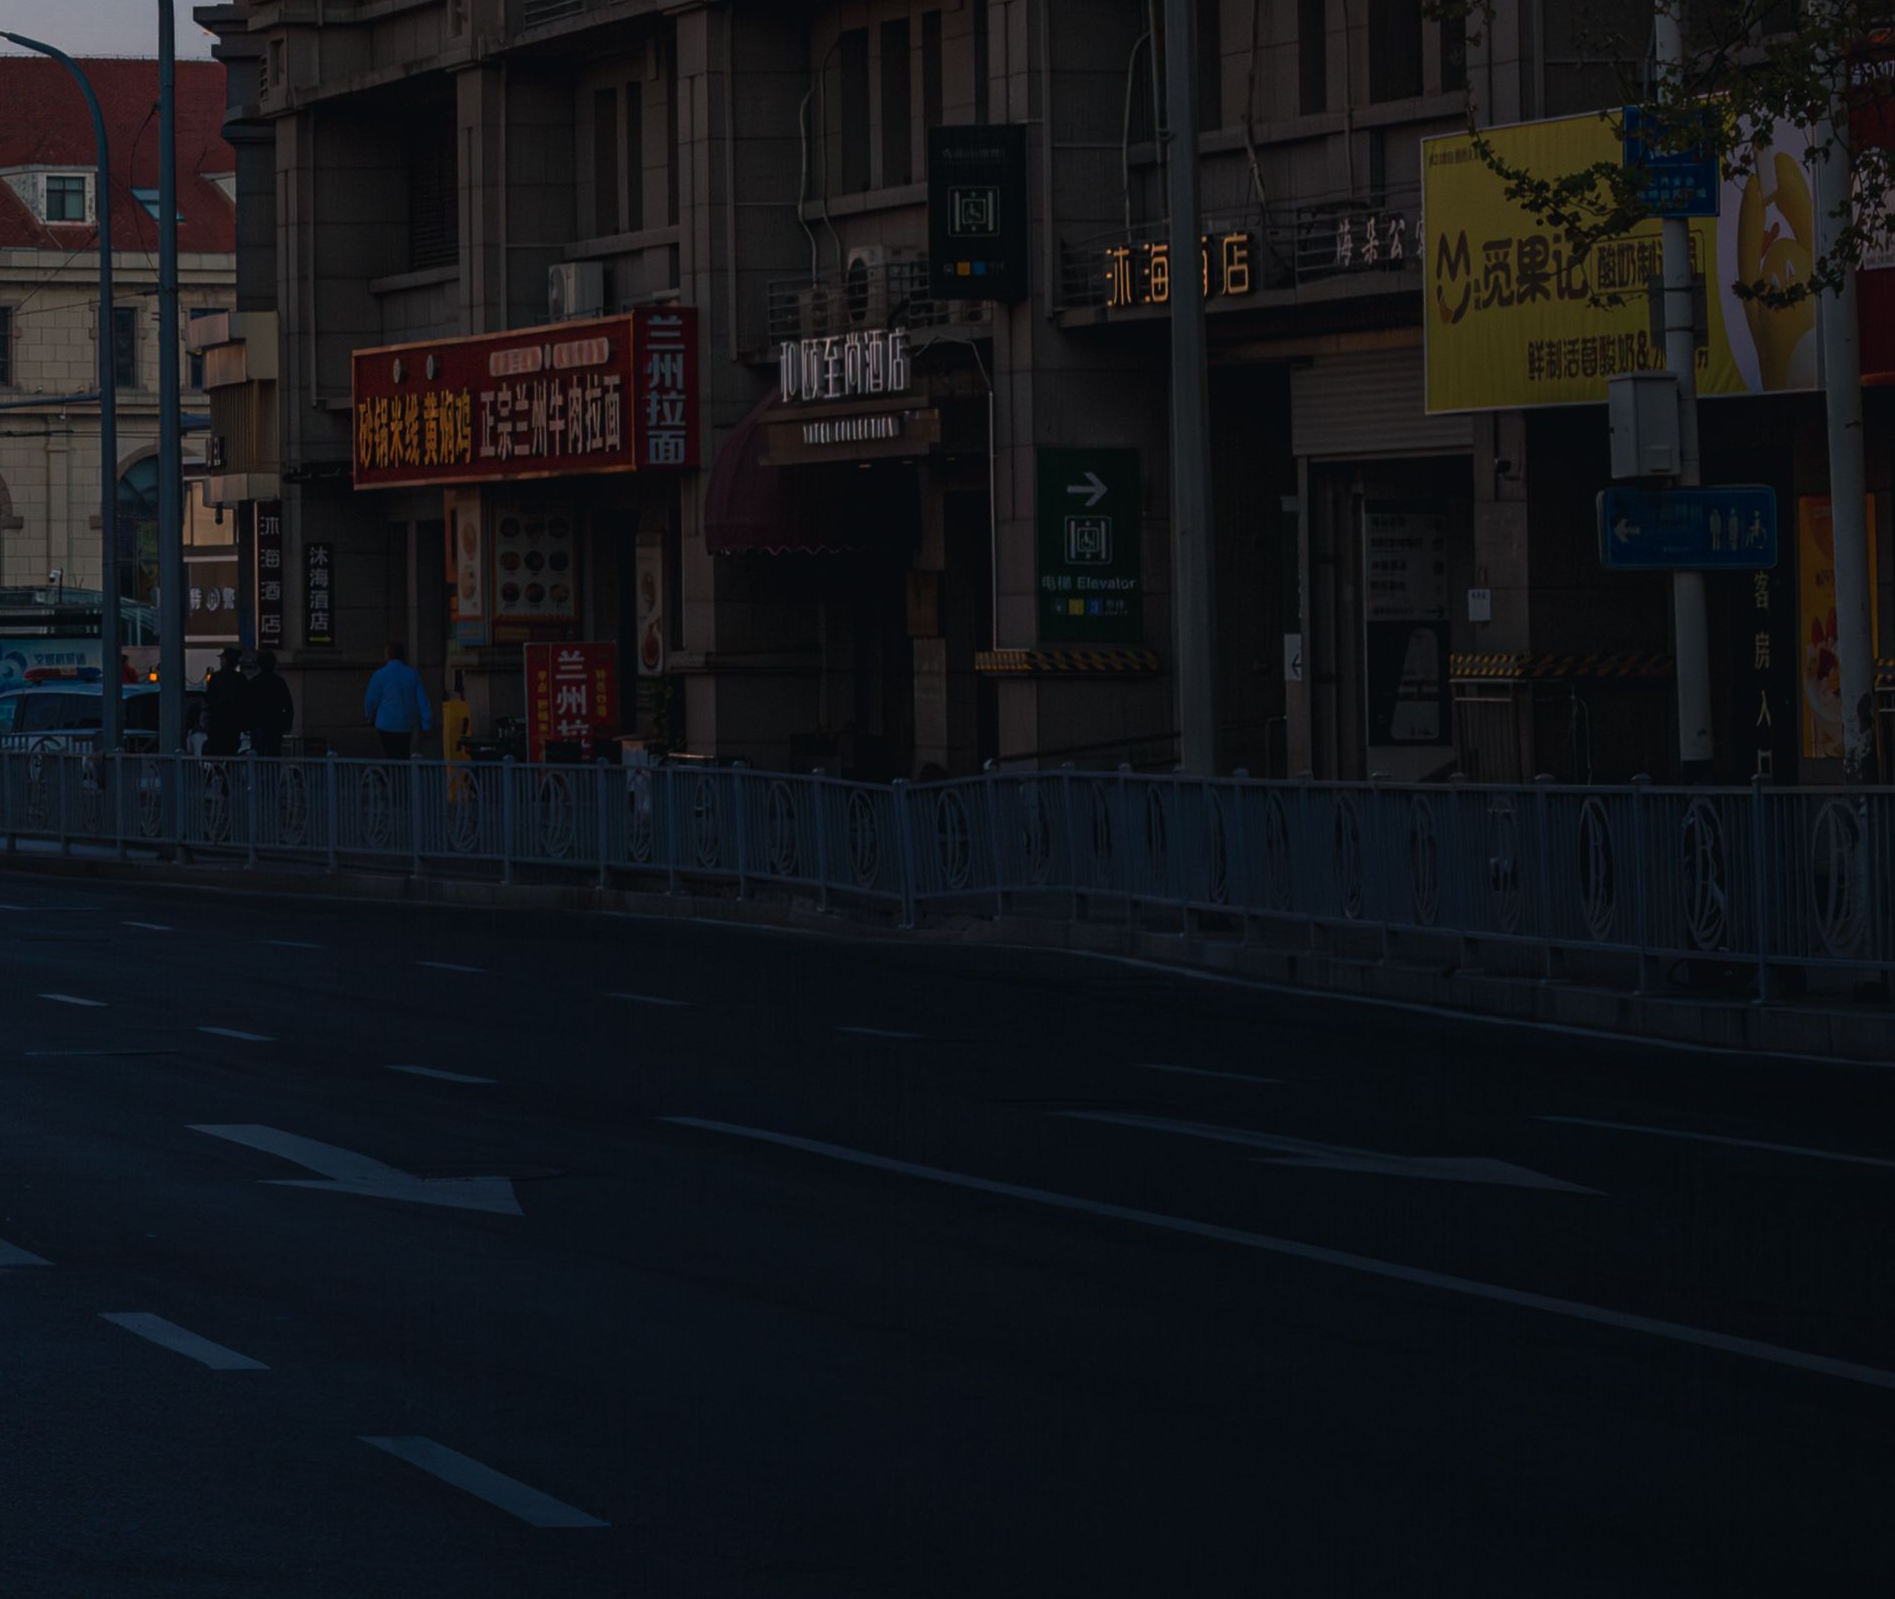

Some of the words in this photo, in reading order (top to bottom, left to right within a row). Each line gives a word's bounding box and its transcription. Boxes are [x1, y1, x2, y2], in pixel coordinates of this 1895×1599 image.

[1105, 231, 1250, 306] 沐海店
[645, 314, 687, 466] 兰州拉面
[779, 326, 907, 403] 和颐至尚酒店
[479, 373, 622, 462] 正宗兰州牛肉拉面
[260, 515, 282, 634] 沐海酒店
[309, 545, 330, 631] 沐海酒店
[1076, 576, 1136, 590] Elevator
[1754, 570, 1773, 776] 客房入口
